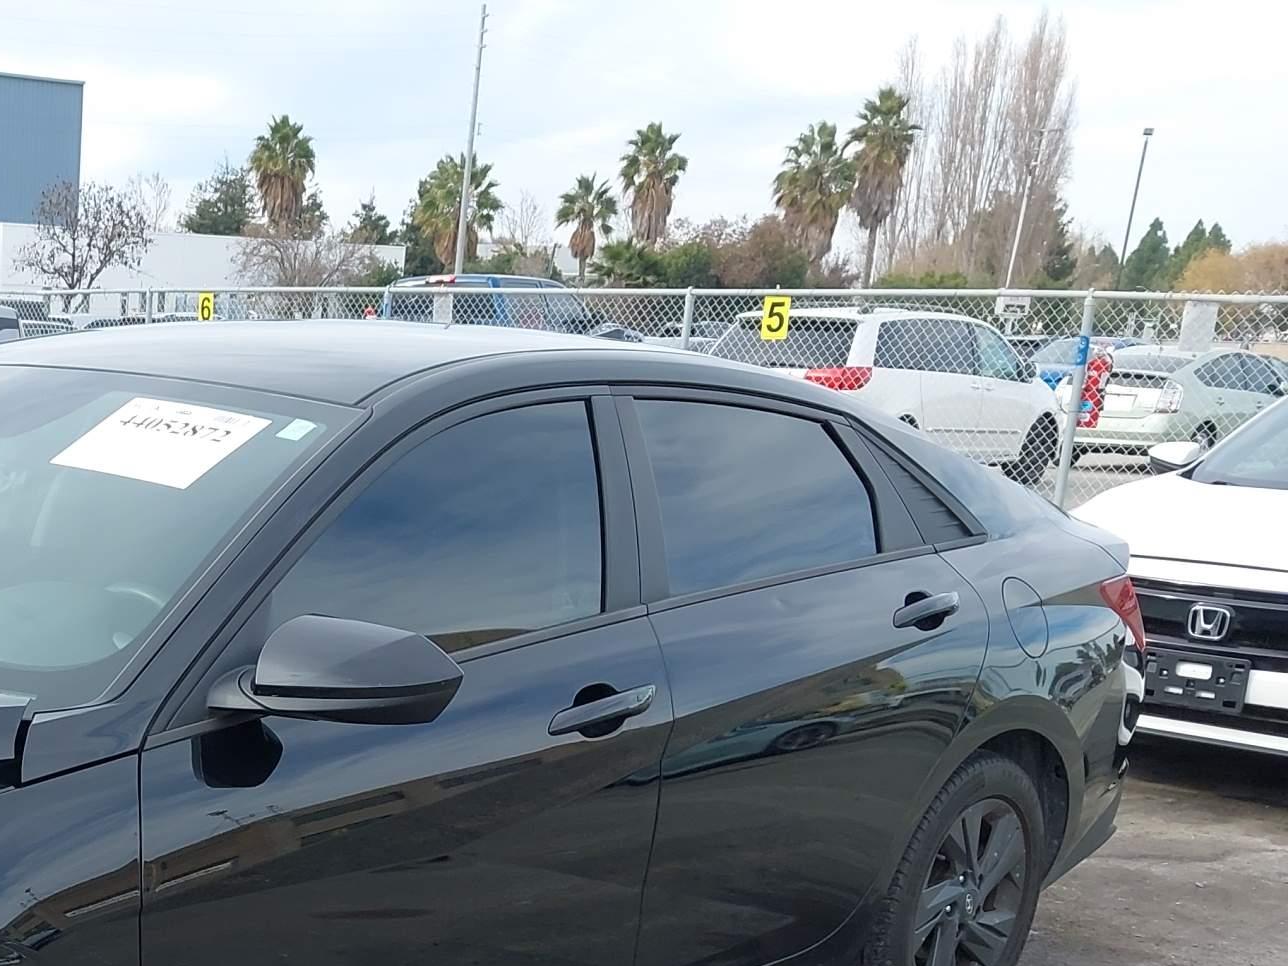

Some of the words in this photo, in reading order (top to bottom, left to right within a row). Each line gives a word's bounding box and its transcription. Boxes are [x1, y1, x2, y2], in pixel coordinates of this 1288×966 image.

[201, 296, 211, 320] 6
[766, 301, 785, 333] 5
[119, 414, 232, 443] 44052872
